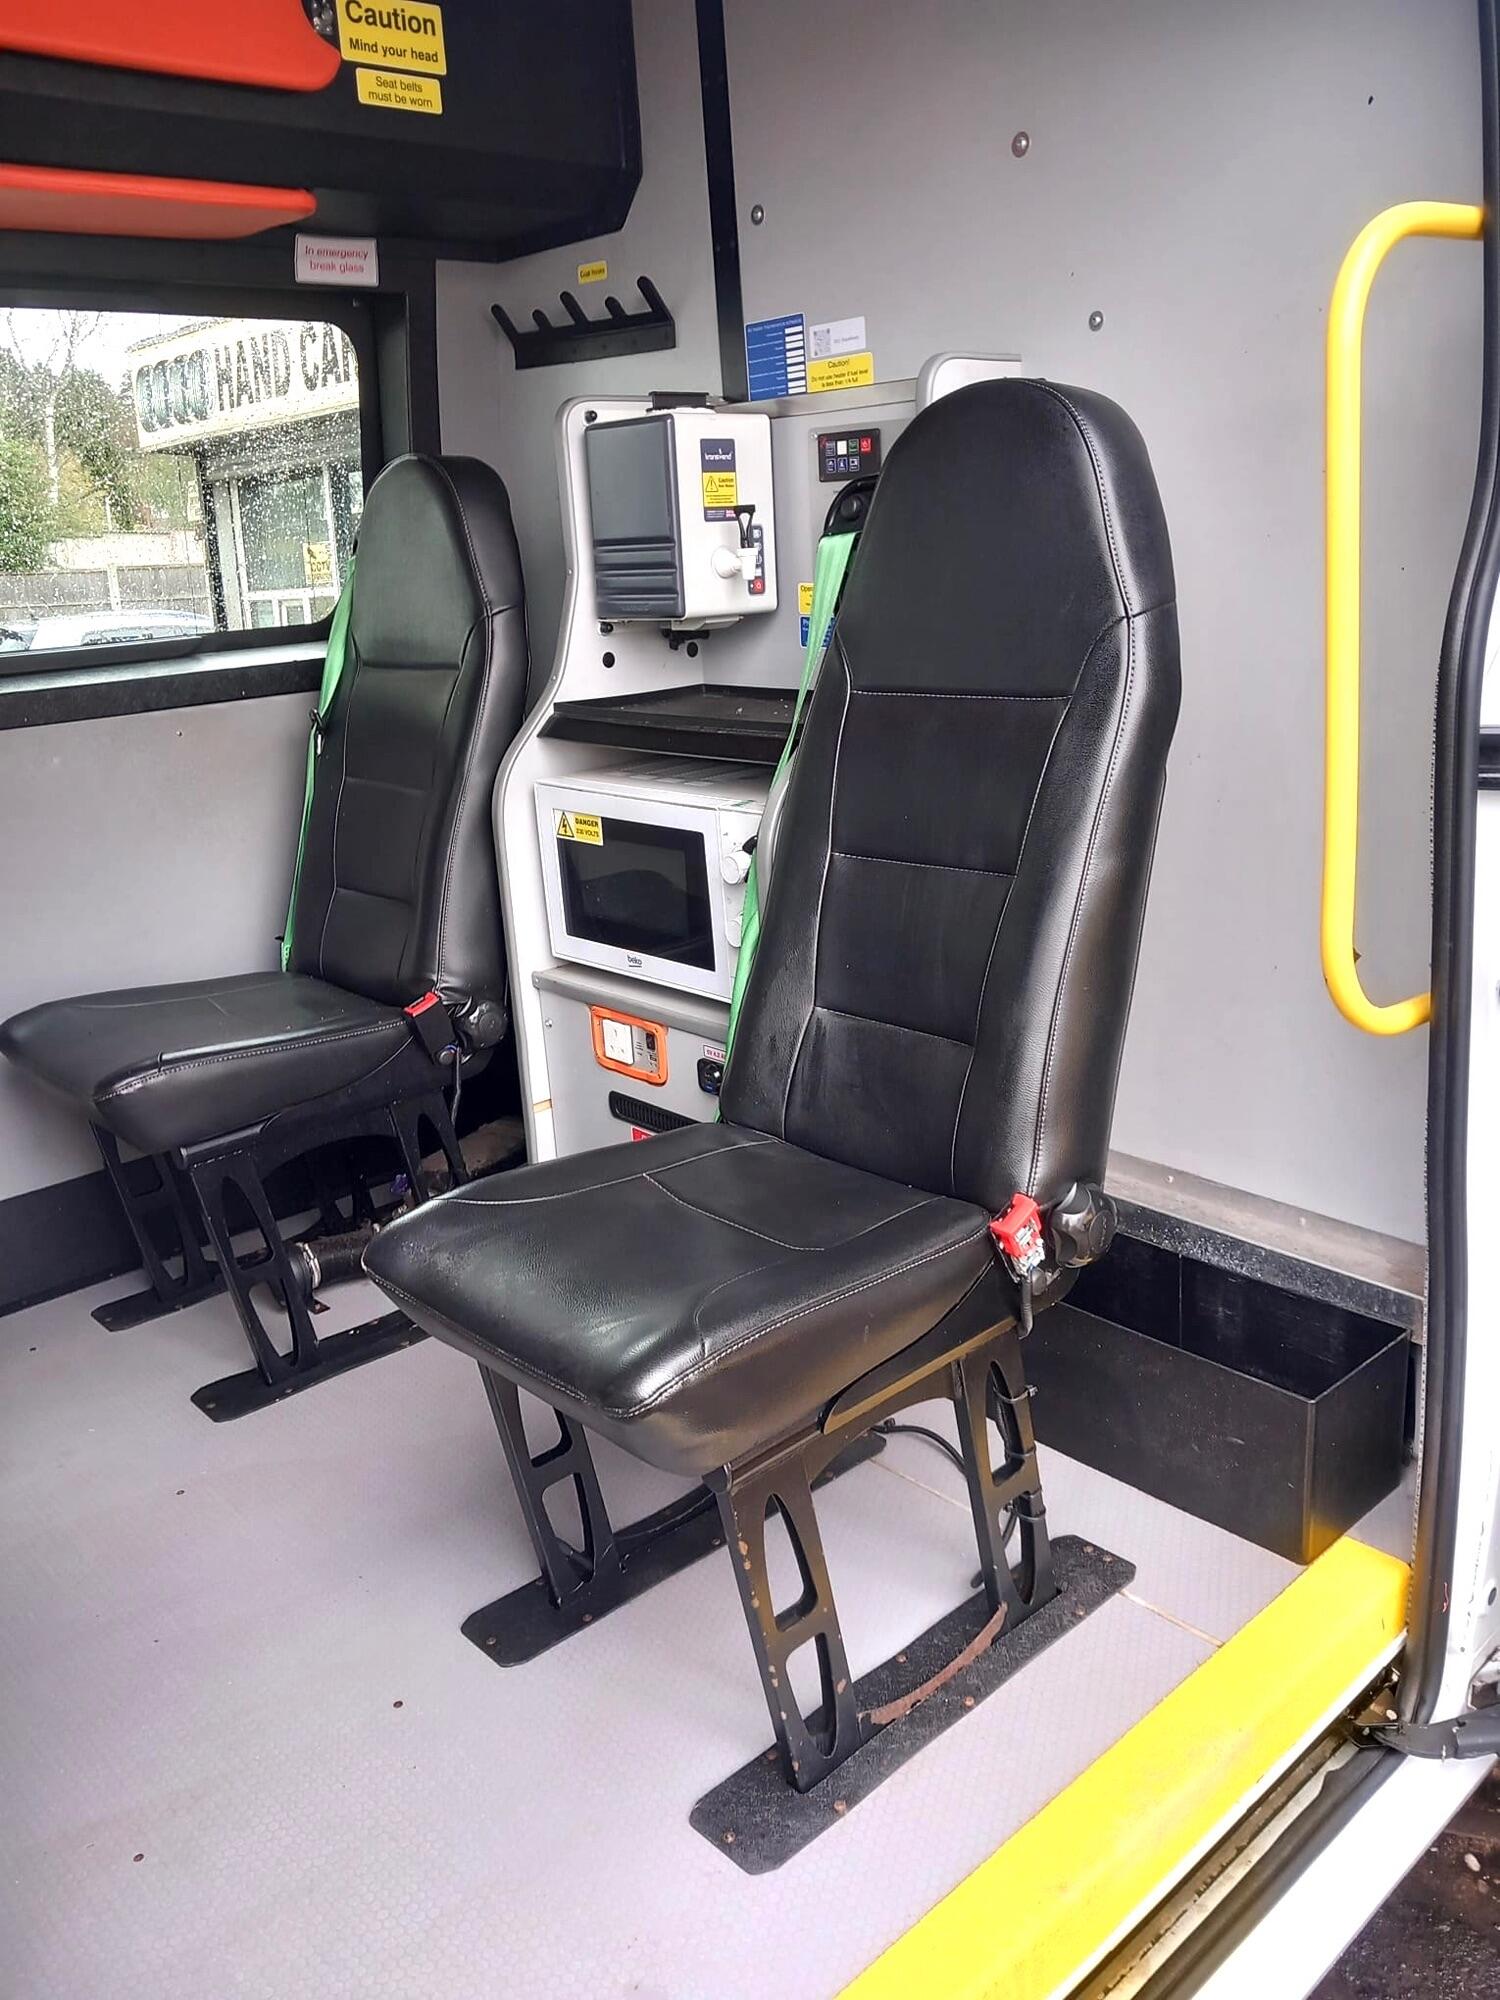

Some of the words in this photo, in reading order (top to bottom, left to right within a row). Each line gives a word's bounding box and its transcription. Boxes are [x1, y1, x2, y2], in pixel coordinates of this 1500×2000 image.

[345, 0, 436, 36] Caution
[349, 37, 378, 53] Mind
[382, 46, 407, 57] your
[411, 48, 438, 62] head
[376, 76, 398, 89] Seat
[400, 80, 423, 93] belts
[368, 90, 393, 103] must
[395, 93, 407, 104] be
[409, 97, 433, 108] worn
[305, 245, 314, 255] In
[317, 249, 368, 260] emergency
[310, 260, 336, 271] break
[339, 262, 364, 273] glass
[215, 330, 290, 411] HAND
[575, 817, 599, 828] DANGER
[585, 829, 599, 837] VOLTS
[627, 954, 643, 965] beko
